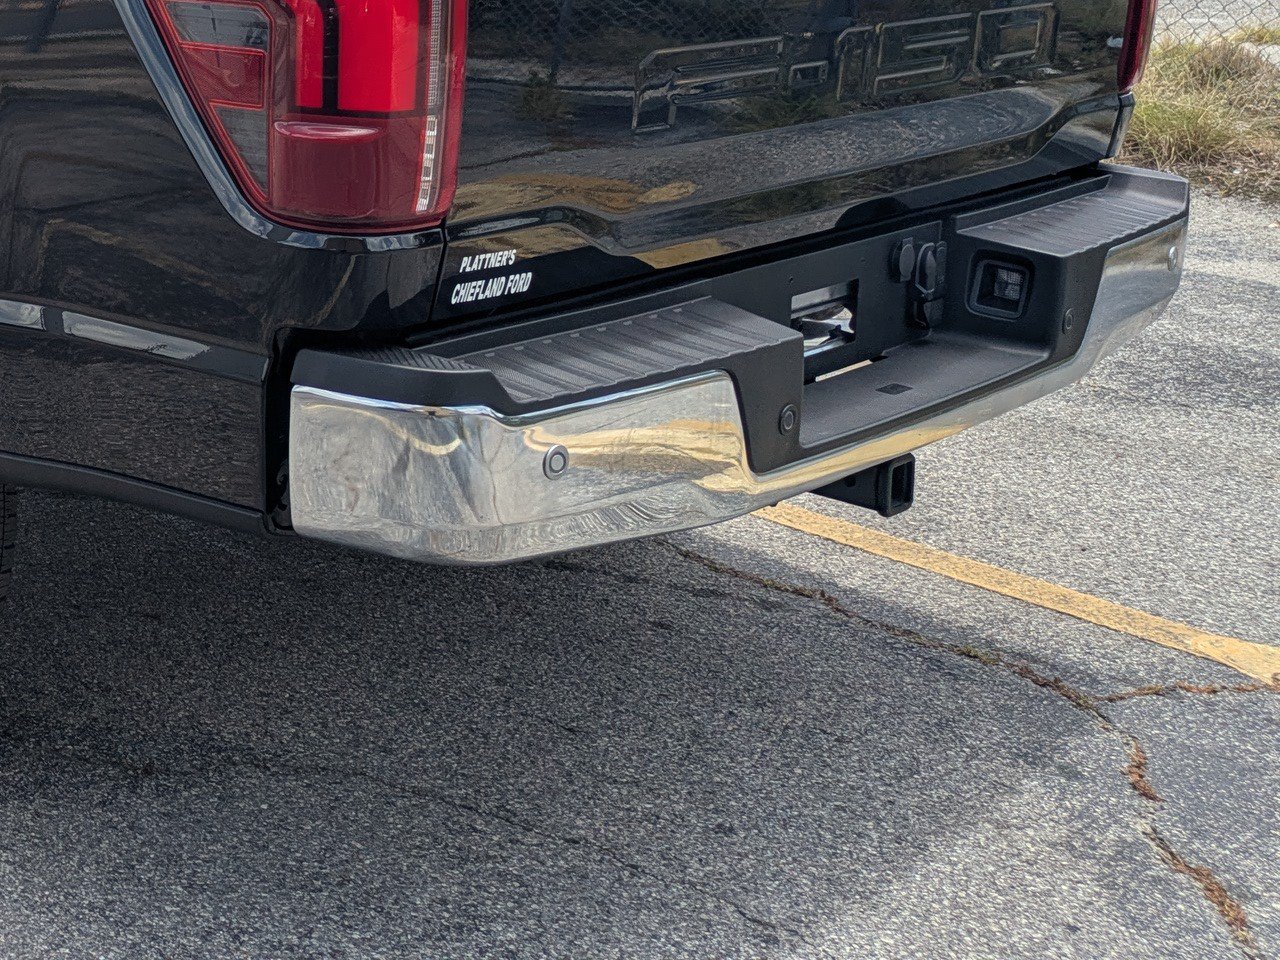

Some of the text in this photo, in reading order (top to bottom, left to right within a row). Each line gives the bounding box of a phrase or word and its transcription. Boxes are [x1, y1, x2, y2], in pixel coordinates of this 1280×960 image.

[459, 249, 517, 273] PLATTNER'S
[450, 271, 533, 305] CHIEFLAND FORD
